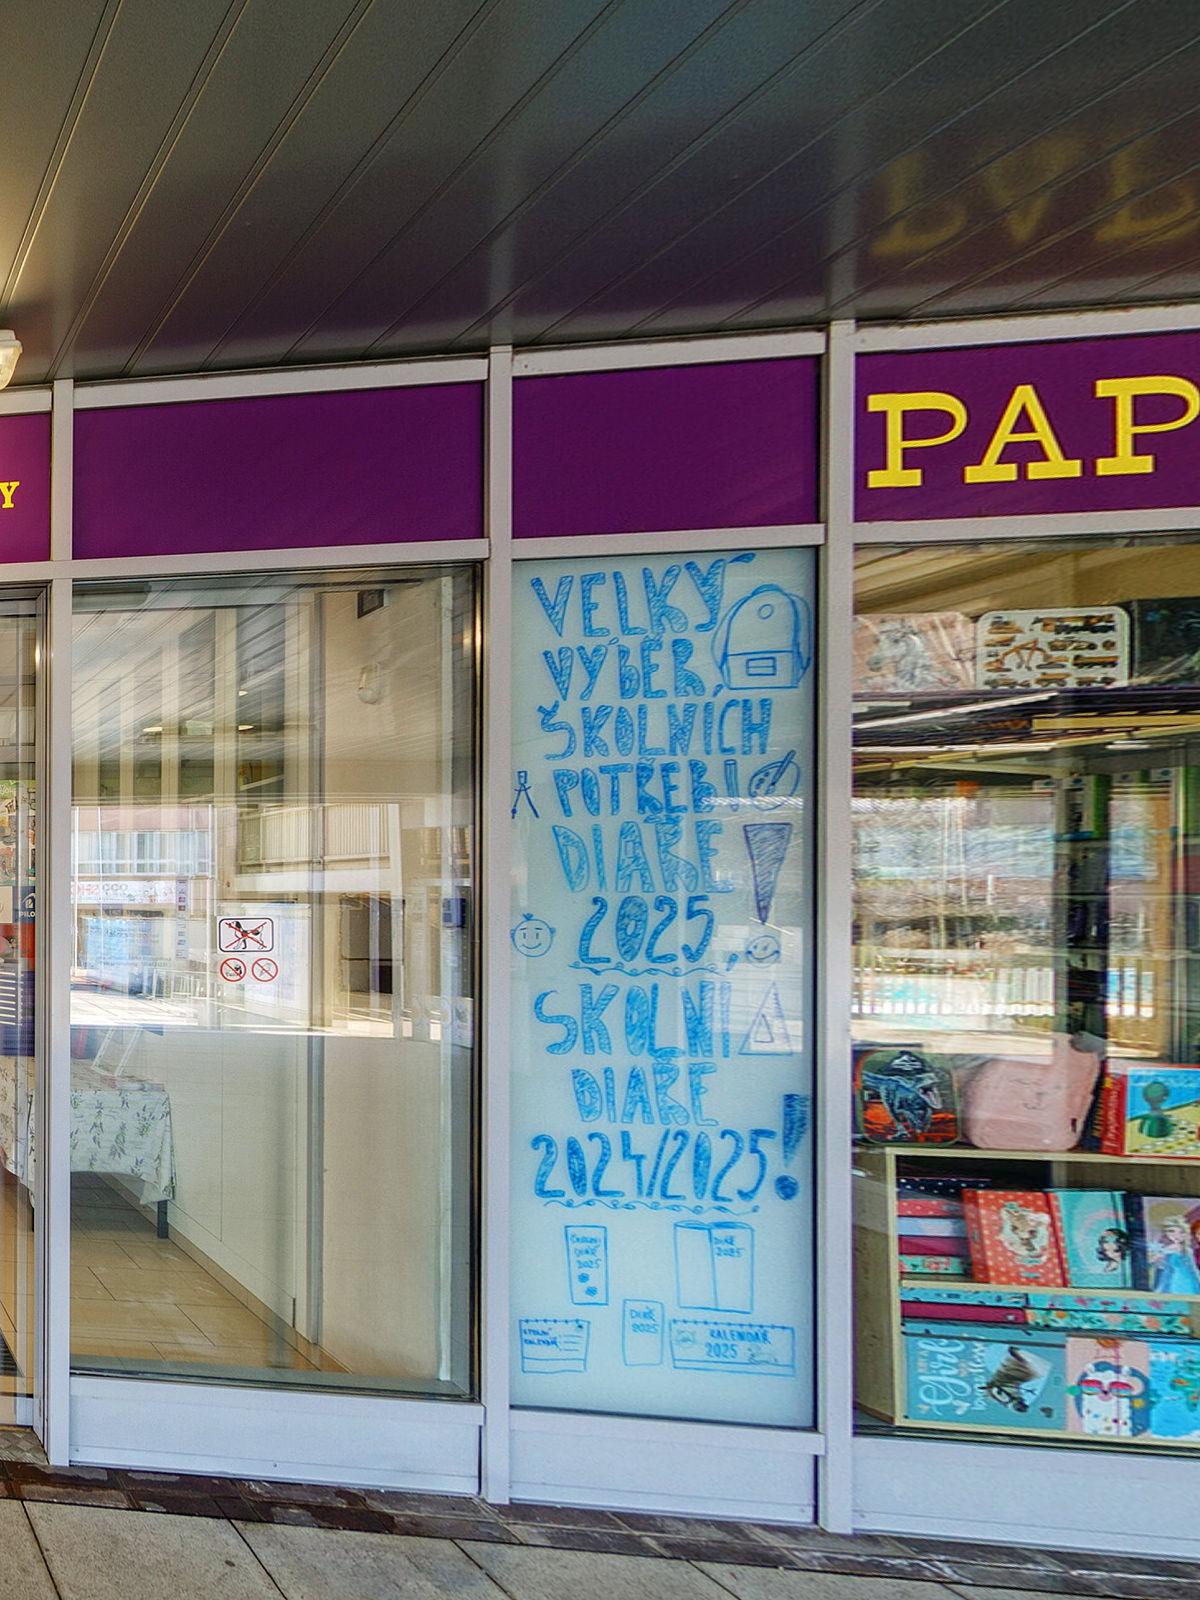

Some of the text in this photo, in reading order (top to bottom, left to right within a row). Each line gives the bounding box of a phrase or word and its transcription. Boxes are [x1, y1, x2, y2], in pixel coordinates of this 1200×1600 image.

[867, 375, 1200, 488] PAP
[579, 895, 715, 964] 2025
[704, 1342, 738, 1359] 2025
